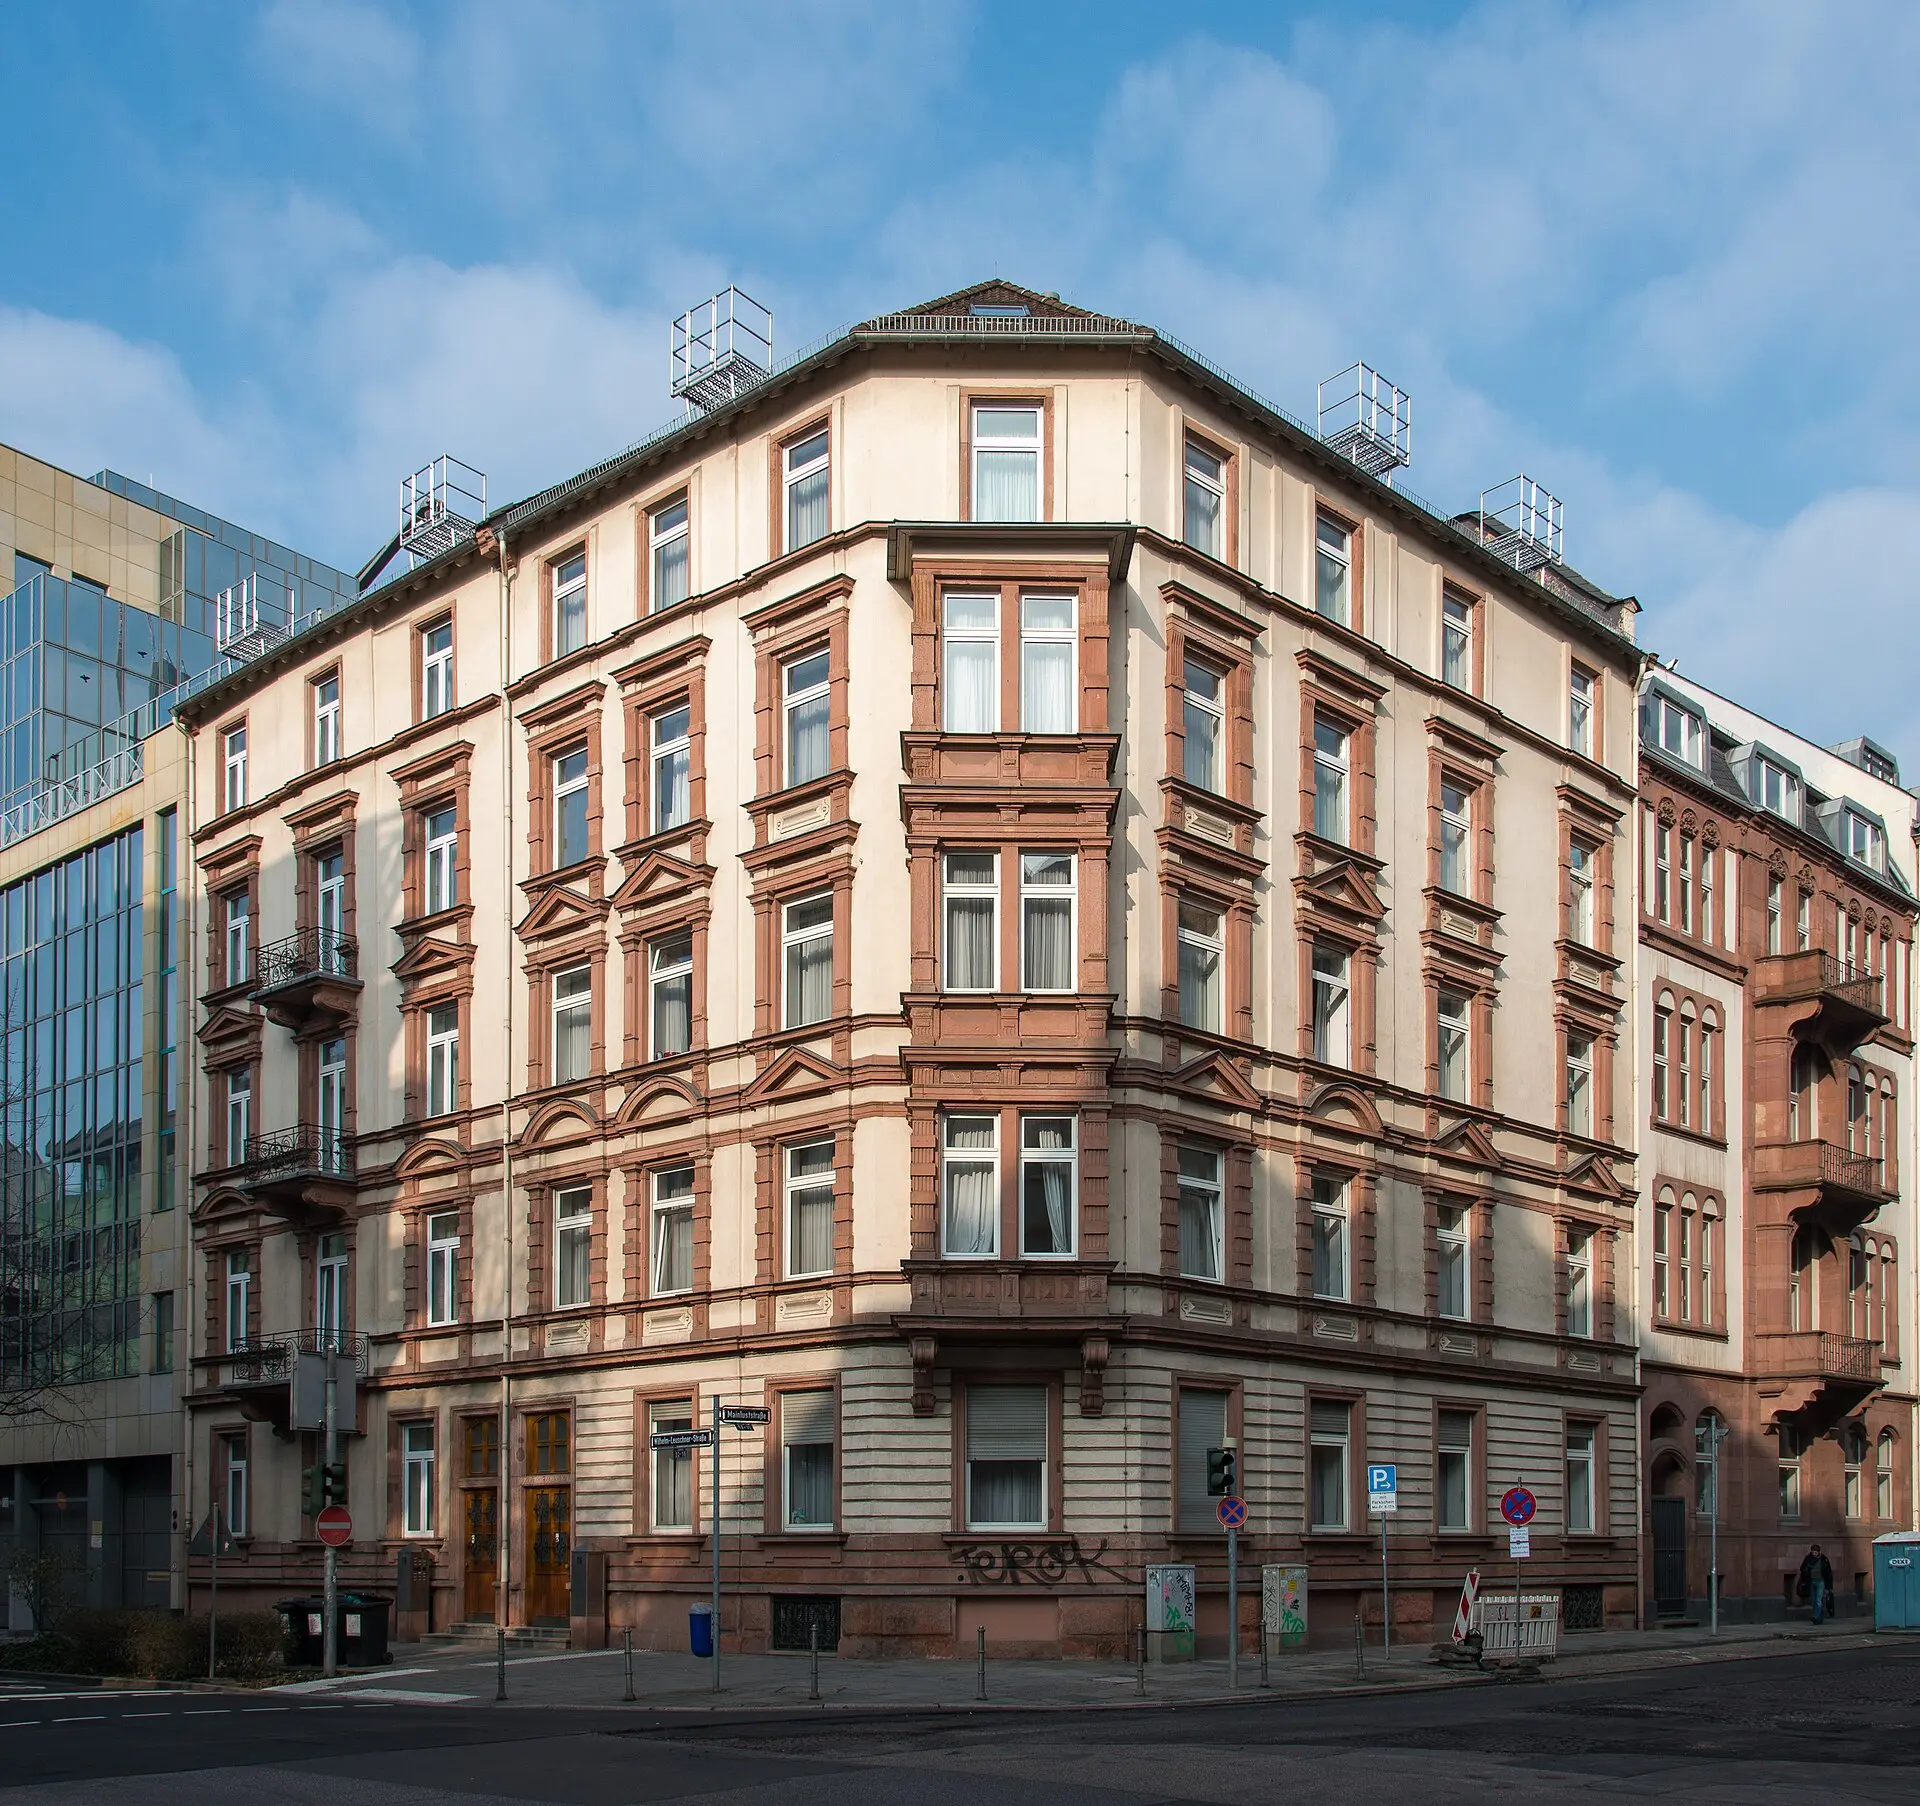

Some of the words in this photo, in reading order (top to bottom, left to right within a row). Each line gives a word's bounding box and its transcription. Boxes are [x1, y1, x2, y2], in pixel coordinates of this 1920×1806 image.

[727, 1410, 767, 1420] Mainluststraße
[654, 1434, 707, 1445] Wilhelm-Leuschner-Straße
[1373, 1469, 1387, 1489] P
